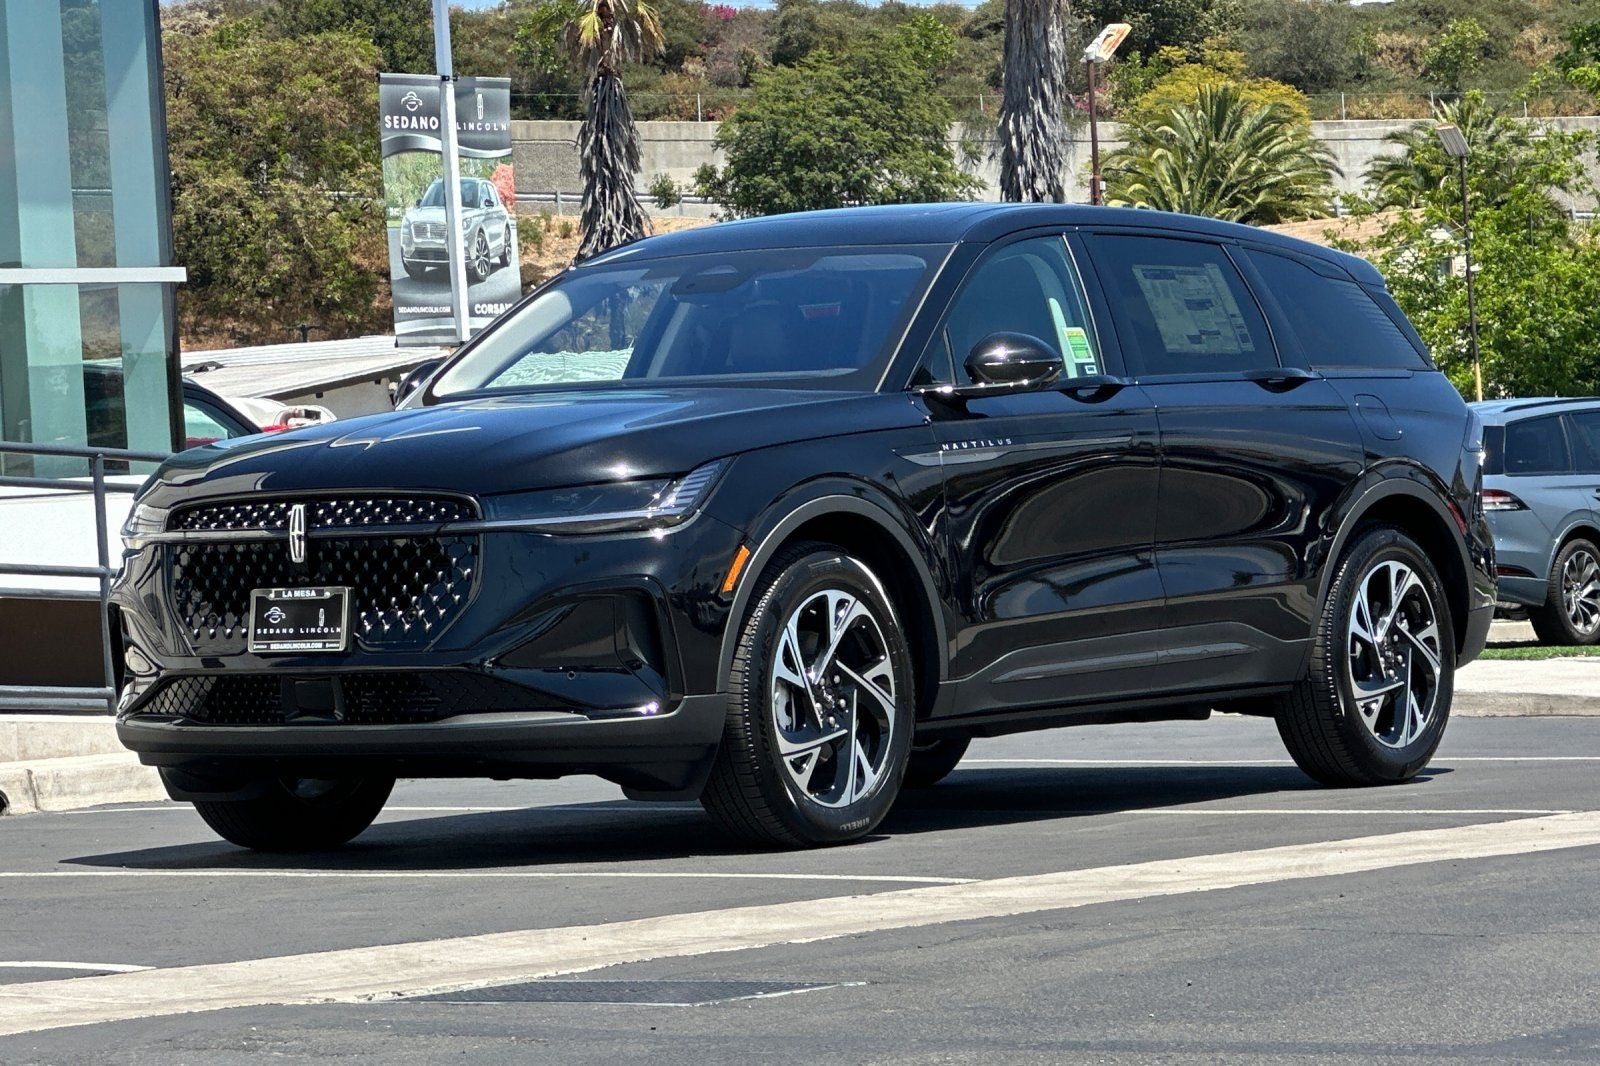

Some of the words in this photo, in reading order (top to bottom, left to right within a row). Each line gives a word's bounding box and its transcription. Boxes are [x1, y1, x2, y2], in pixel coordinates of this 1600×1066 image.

[384, 114, 439, 130] SEDANO
[456, 121, 508, 131] LINCOLN
[942, 438, 1012, 451] NAUTILUS
[282, 590, 293, 598] LA
[294, 590, 316, 598] MESA
